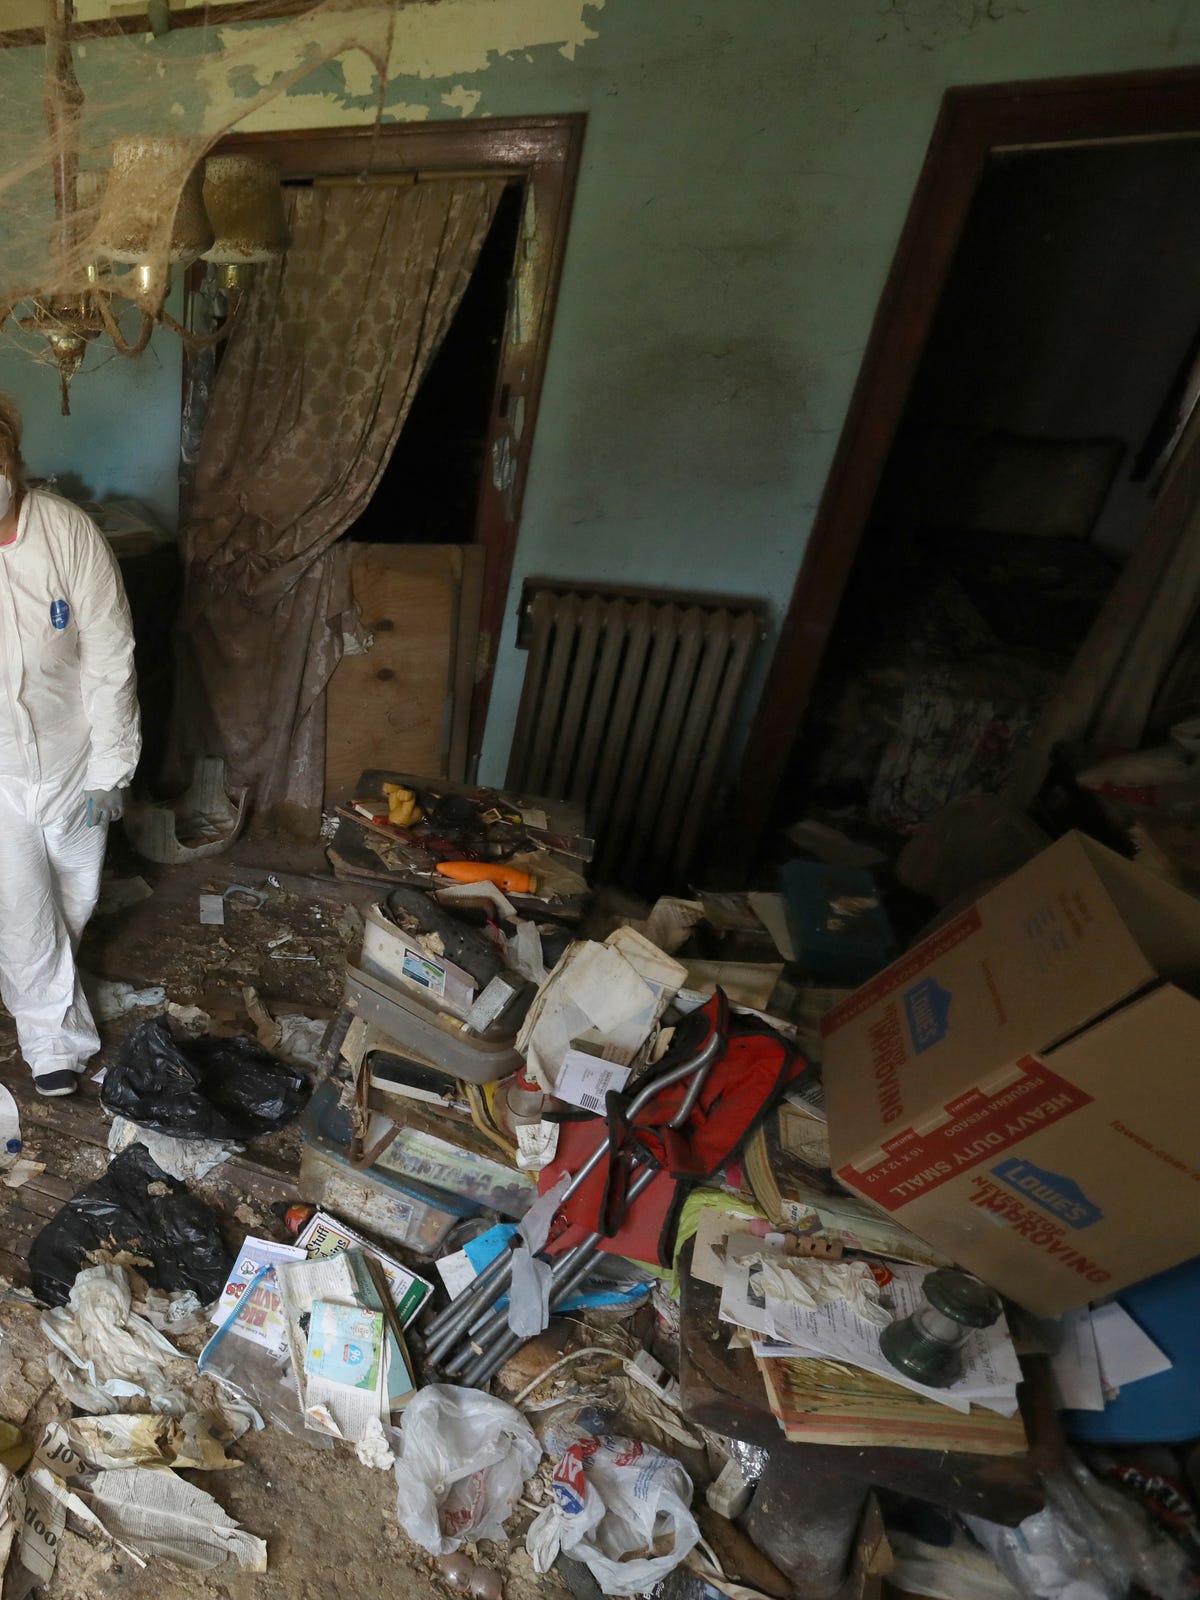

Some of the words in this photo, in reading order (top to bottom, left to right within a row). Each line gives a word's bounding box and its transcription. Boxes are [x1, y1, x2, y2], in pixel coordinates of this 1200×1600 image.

[943, 1106, 991, 1138] PESADO
[1013, 1092, 1073, 1130] HEAVY
[954, 1127, 1005, 1166] DUTY
[889, 1153, 954, 1198] SMALL
[972, 1176, 1027, 1213] NEVER
[1003, 1164, 1086, 1224] LOWE'S
[305, 1226, 330, 1253] Stuff
[968, 1188, 1112, 1287] IMPROVING
[46, 1440, 78, 1465] of
